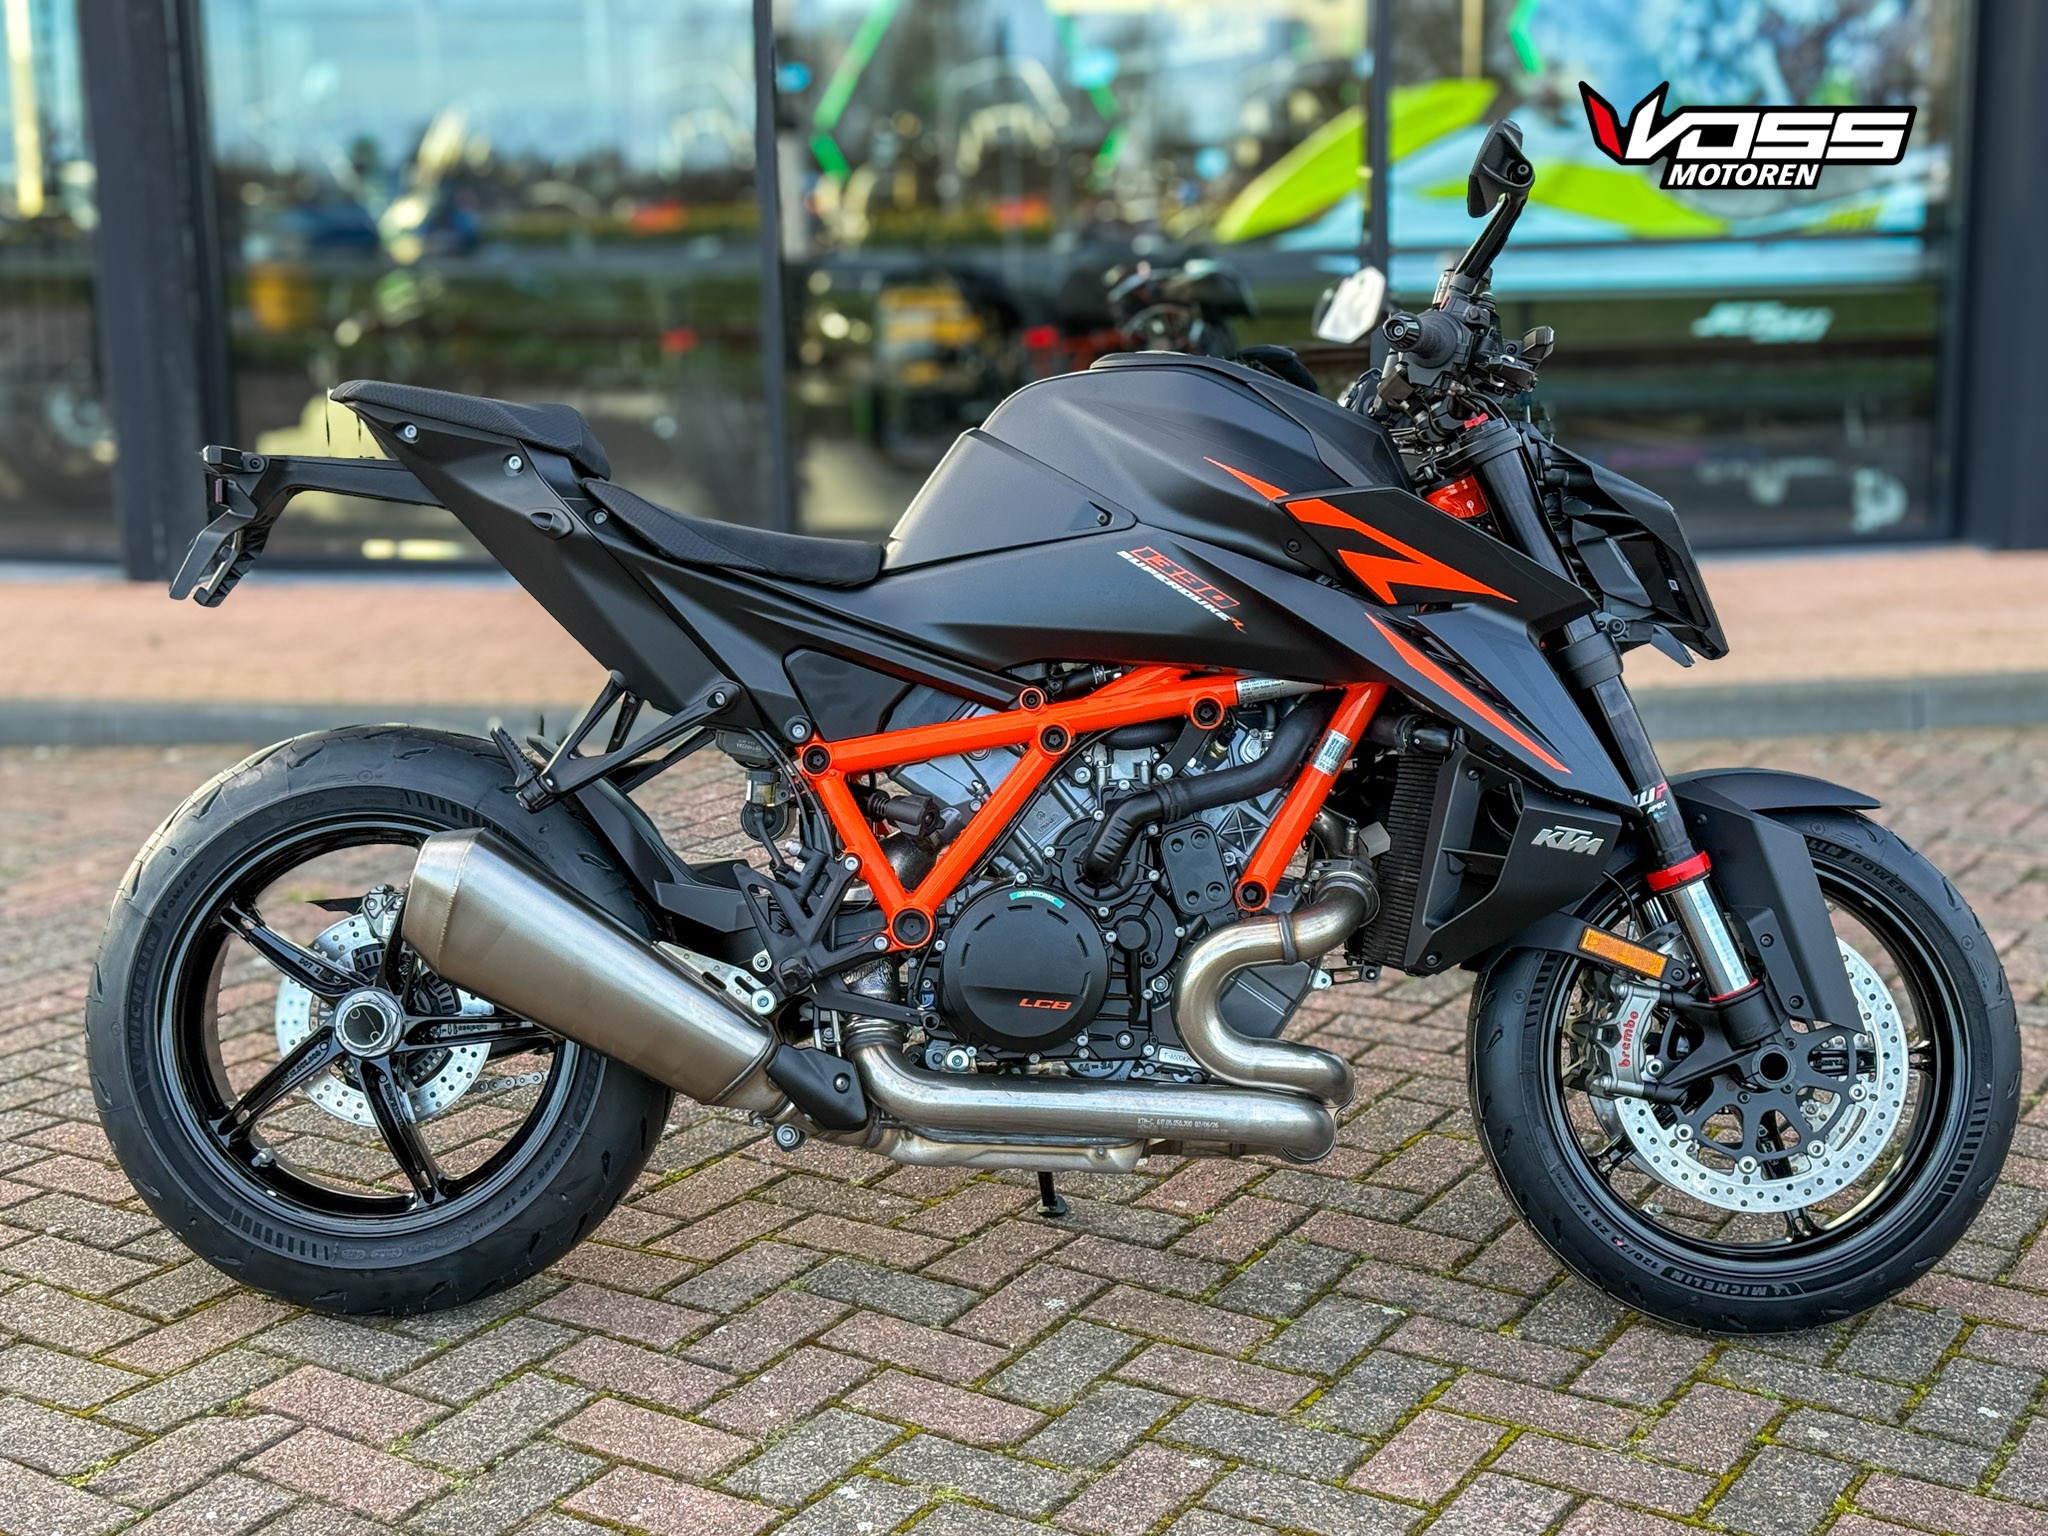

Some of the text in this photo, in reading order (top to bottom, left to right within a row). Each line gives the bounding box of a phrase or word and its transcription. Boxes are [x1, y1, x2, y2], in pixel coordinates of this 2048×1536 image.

[1531, 825, 1604, 856] KTM
[1851, 856, 1907, 896] POWER
[162, 870, 198, 919] POWER
[130, 930, 159, 1051] MICHELIN
[1019, 998, 1072, 1010] LC8
[1618, 1011, 1639, 1068] brembo
[1576, 1203, 1592, 1218] 17
[1591, 1218, 1610, 1235] ZR
[1670, 1270, 1767, 1297] MICHELIN
